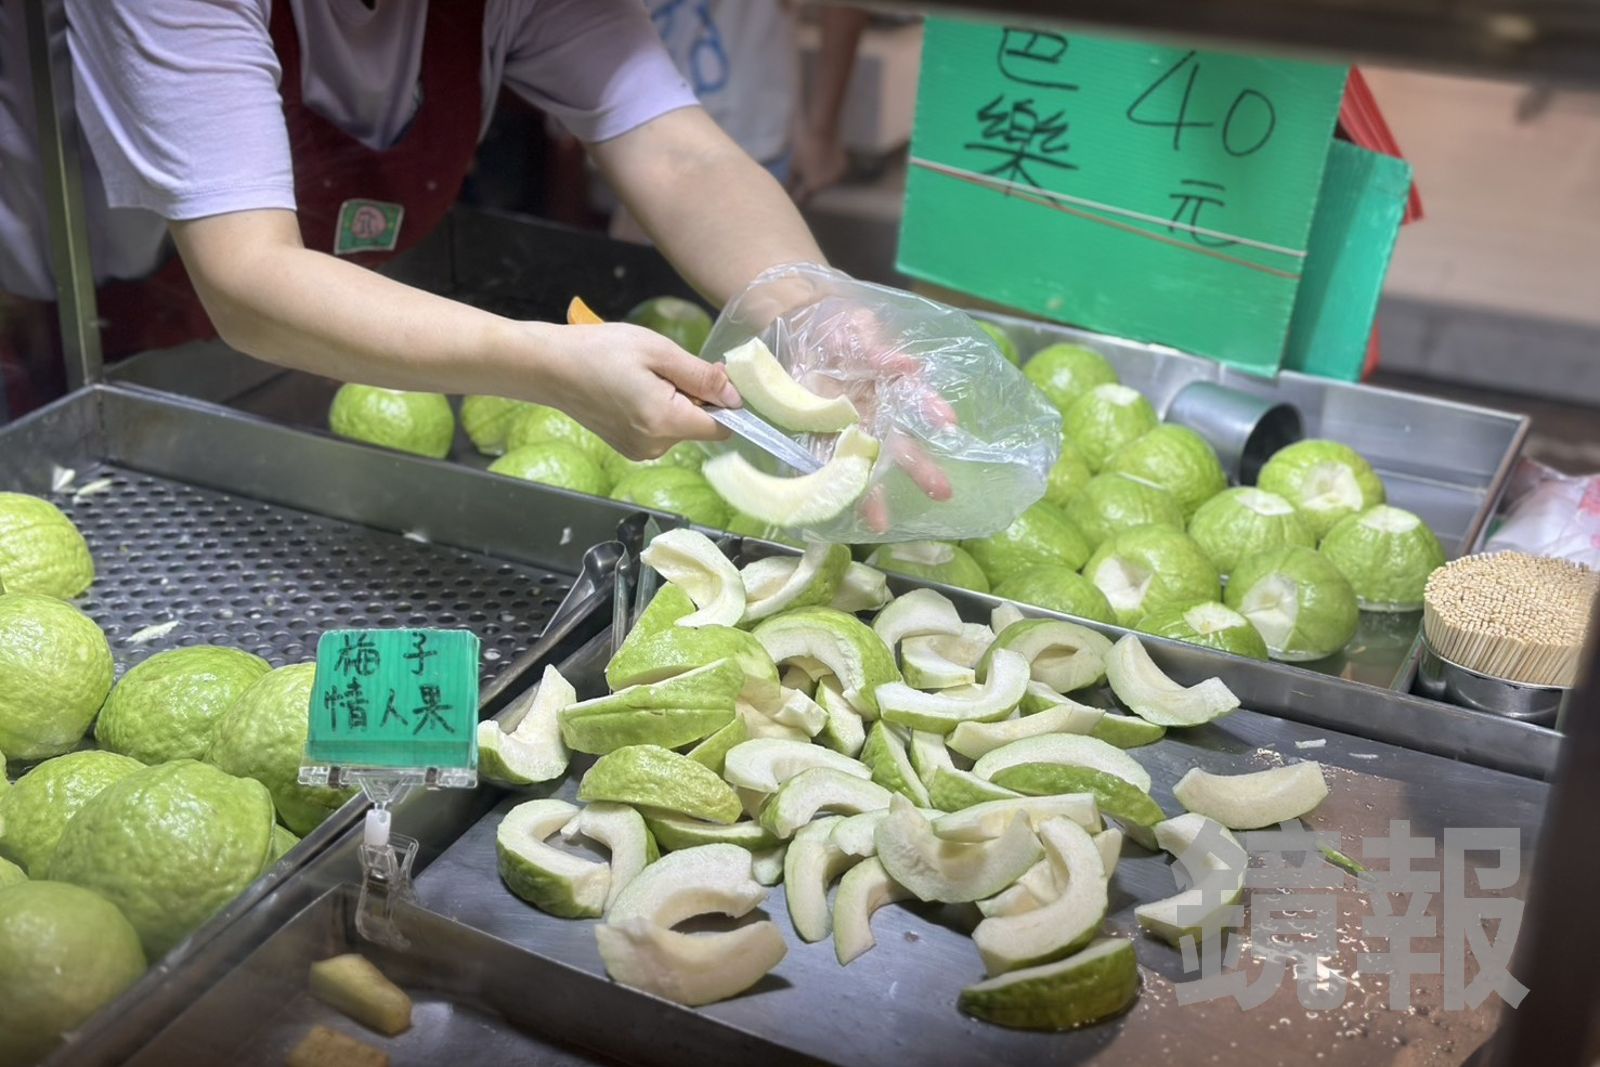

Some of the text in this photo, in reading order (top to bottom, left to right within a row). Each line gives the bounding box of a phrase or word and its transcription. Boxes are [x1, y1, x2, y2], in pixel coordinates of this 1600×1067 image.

[1126, 50, 1276, 157] 40
[1168, 179, 1238, 247] 元
[334, 631, 438, 676] 梅子
[323, 676, 456, 736] 情人果
